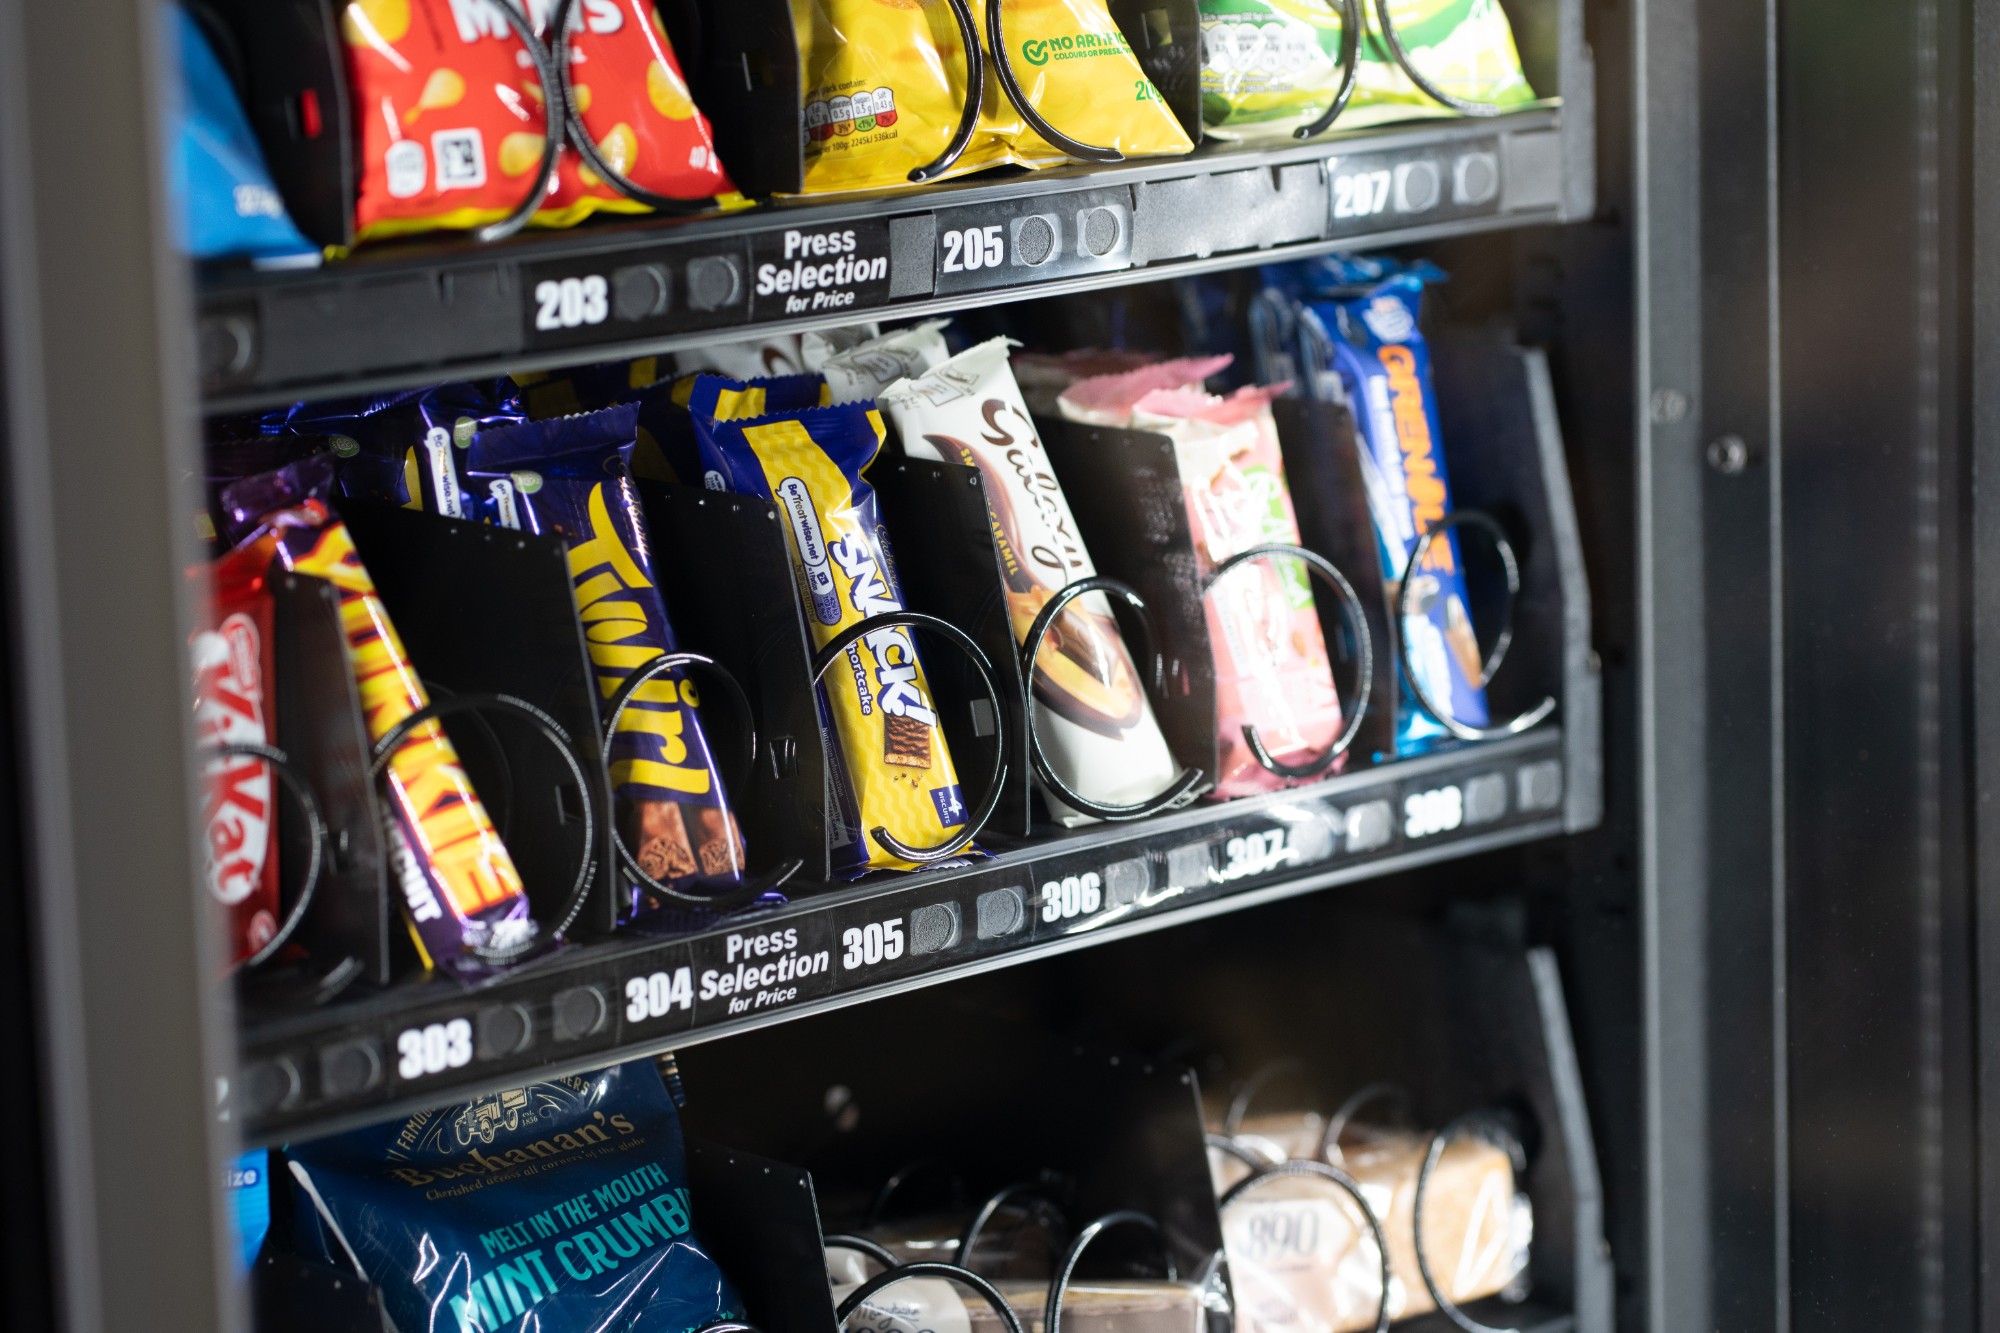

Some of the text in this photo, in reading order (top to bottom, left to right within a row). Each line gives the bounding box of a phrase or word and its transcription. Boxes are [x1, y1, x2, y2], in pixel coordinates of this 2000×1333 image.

[1048, 36, 1073, 51] NO
[1054, 50, 1088, 60] COLOURS
[1088, 49, 1098, 58] OR
[833, 108, 845, 119] 0.5
[854, 94, 871, 104] Sugars
[855, 104, 867, 114] 0.5
[877, 90, 886, 100] Salt
[1334, 169, 1392, 220] 207
[784, 230, 857, 260] Press
[943, 225, 1005, 274] 205
[756, 253, 888, 296] Selection
[534, 274, 608, 331] 203
[785, 289, 856, 314] for Price
[787, 482, 820, 561] BeTreatwise.net
[566, 480, 710, 795] Twirl
[846, 639, 873, 716] hortcake
[292, 523, 524, 918] YORKIE
[938, 791, 950, 824] BISCUITS
[948, 796, 963, 818] 4
[1226, 828, 1287, 881] 307
[1041, 871, 1102, 924] 306
[726, 927, 798, 964] Press
[842, 917, 904, 970] 305
[625, 965, 694, 1024] 304
[699, 949, 829, 1001] Selection
[728, 986, 797, 1015] for Price
[397, 1017, 474, 1081] 303
[522, 1110, 535, 1118] est.
[392, 1109, 636, 1188] Buchanan's
[426, 1136, 647, 1201] Cherished across all corners of the globe
[224, 1168, 258, 1188] ize
[478, 1162, 670, 1259] MELT IN THE MOUTH
[449, 1249, 559, 1333] MINT
